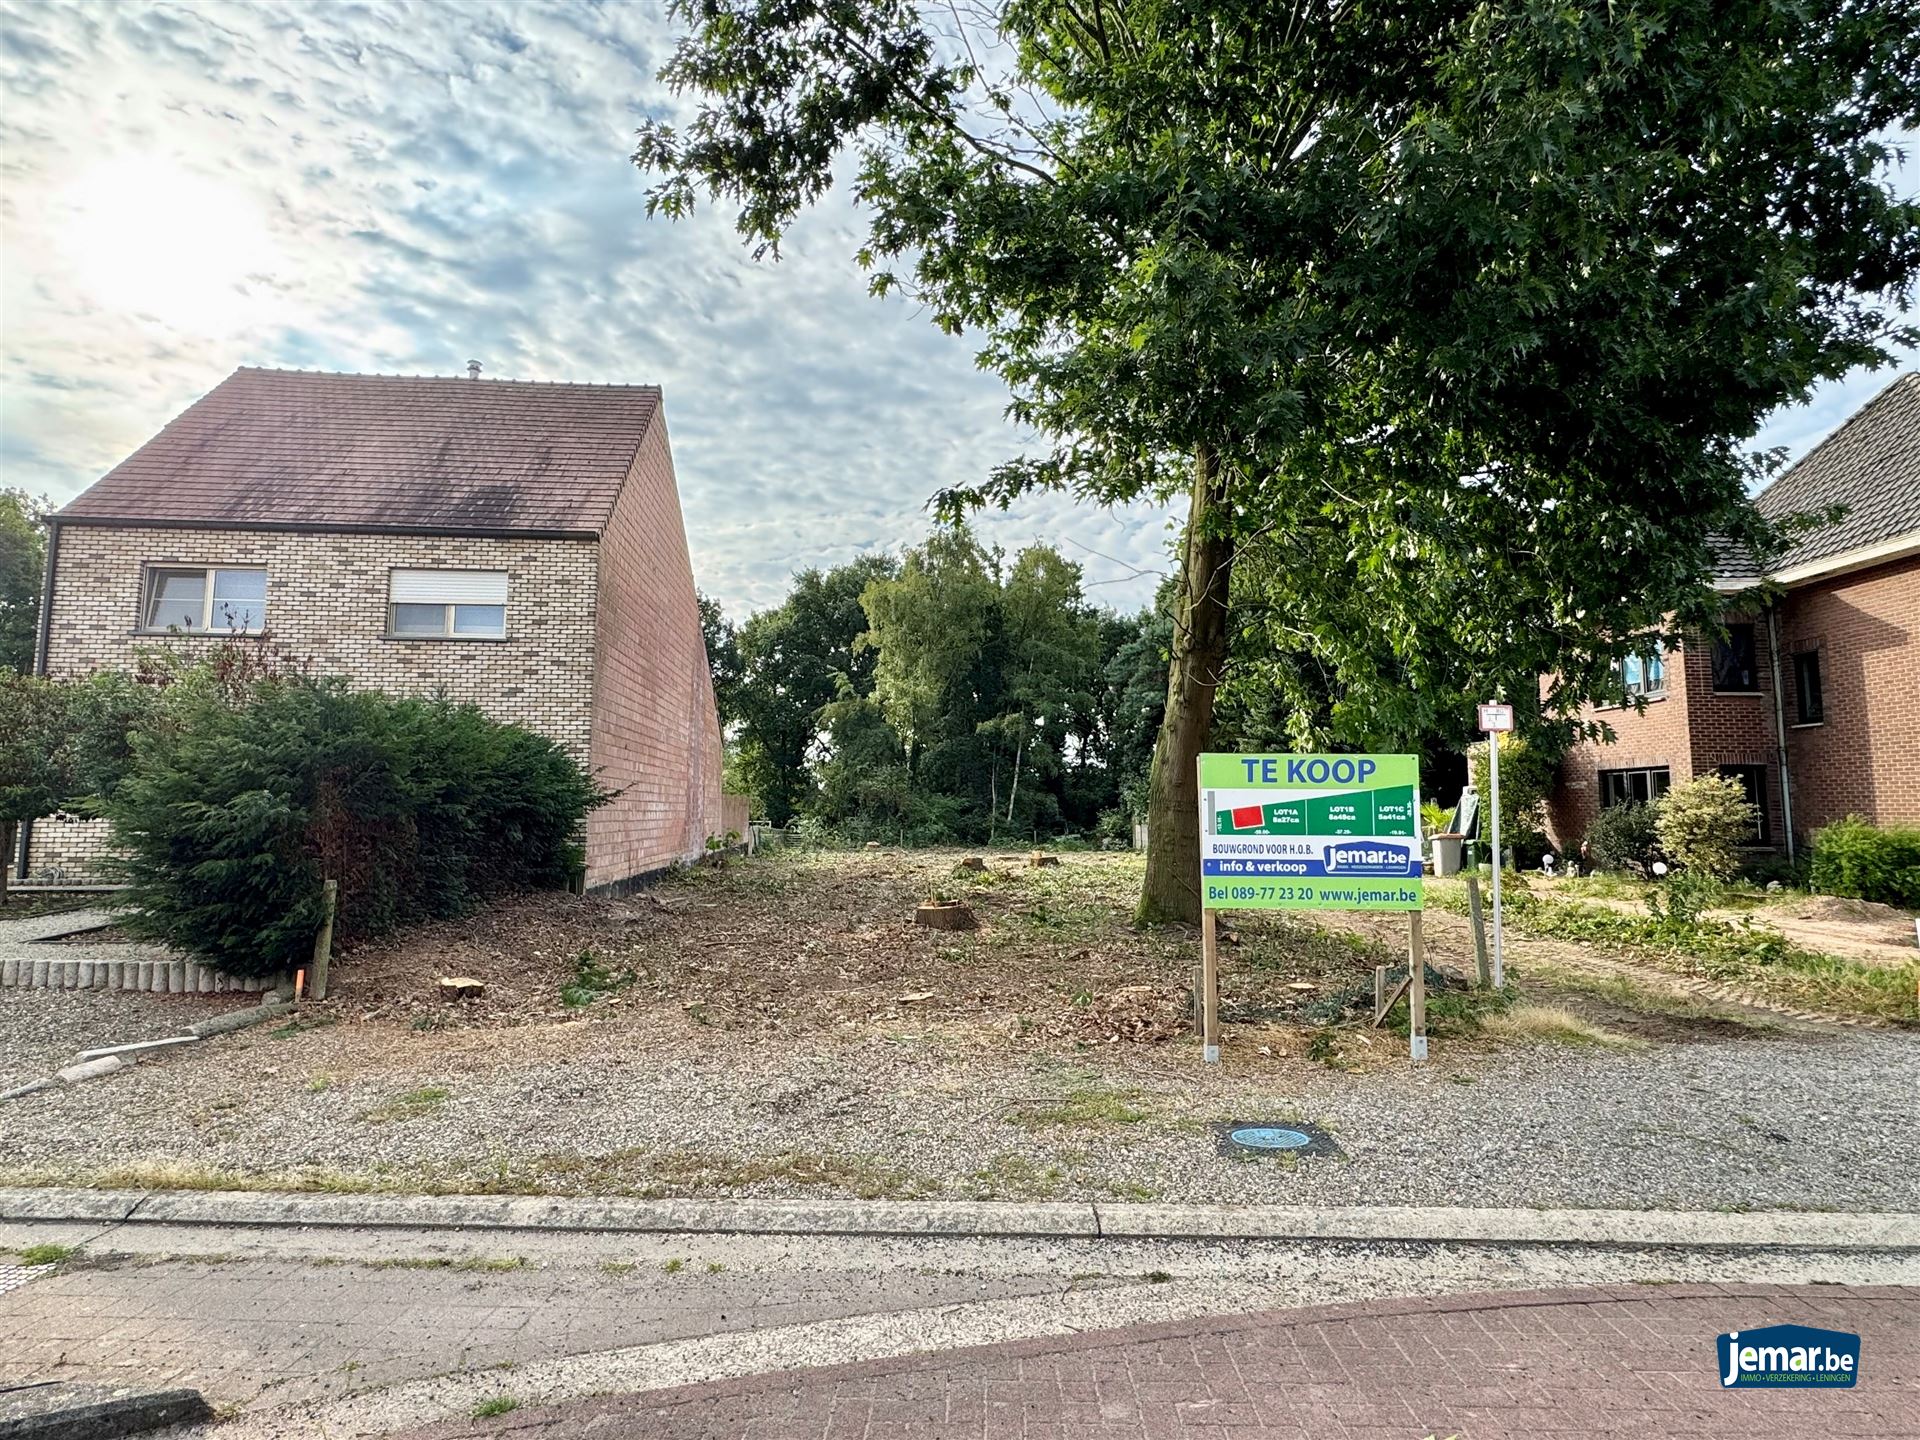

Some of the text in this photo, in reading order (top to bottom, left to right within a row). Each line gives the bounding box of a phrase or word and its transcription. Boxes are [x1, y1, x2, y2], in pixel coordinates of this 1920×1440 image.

[1241, 759, 1376, 784] TE KOOP
[1212, 844, 1314, 855] BOUWGROND VOOR H.O.B.
[1326, 846, 1407, 871] jemar.be
[1219, 860, 1307, 875] info & verkoop
[1209, 887, 1417, 904] Bel 089-77 23 20 www.jemar.be
